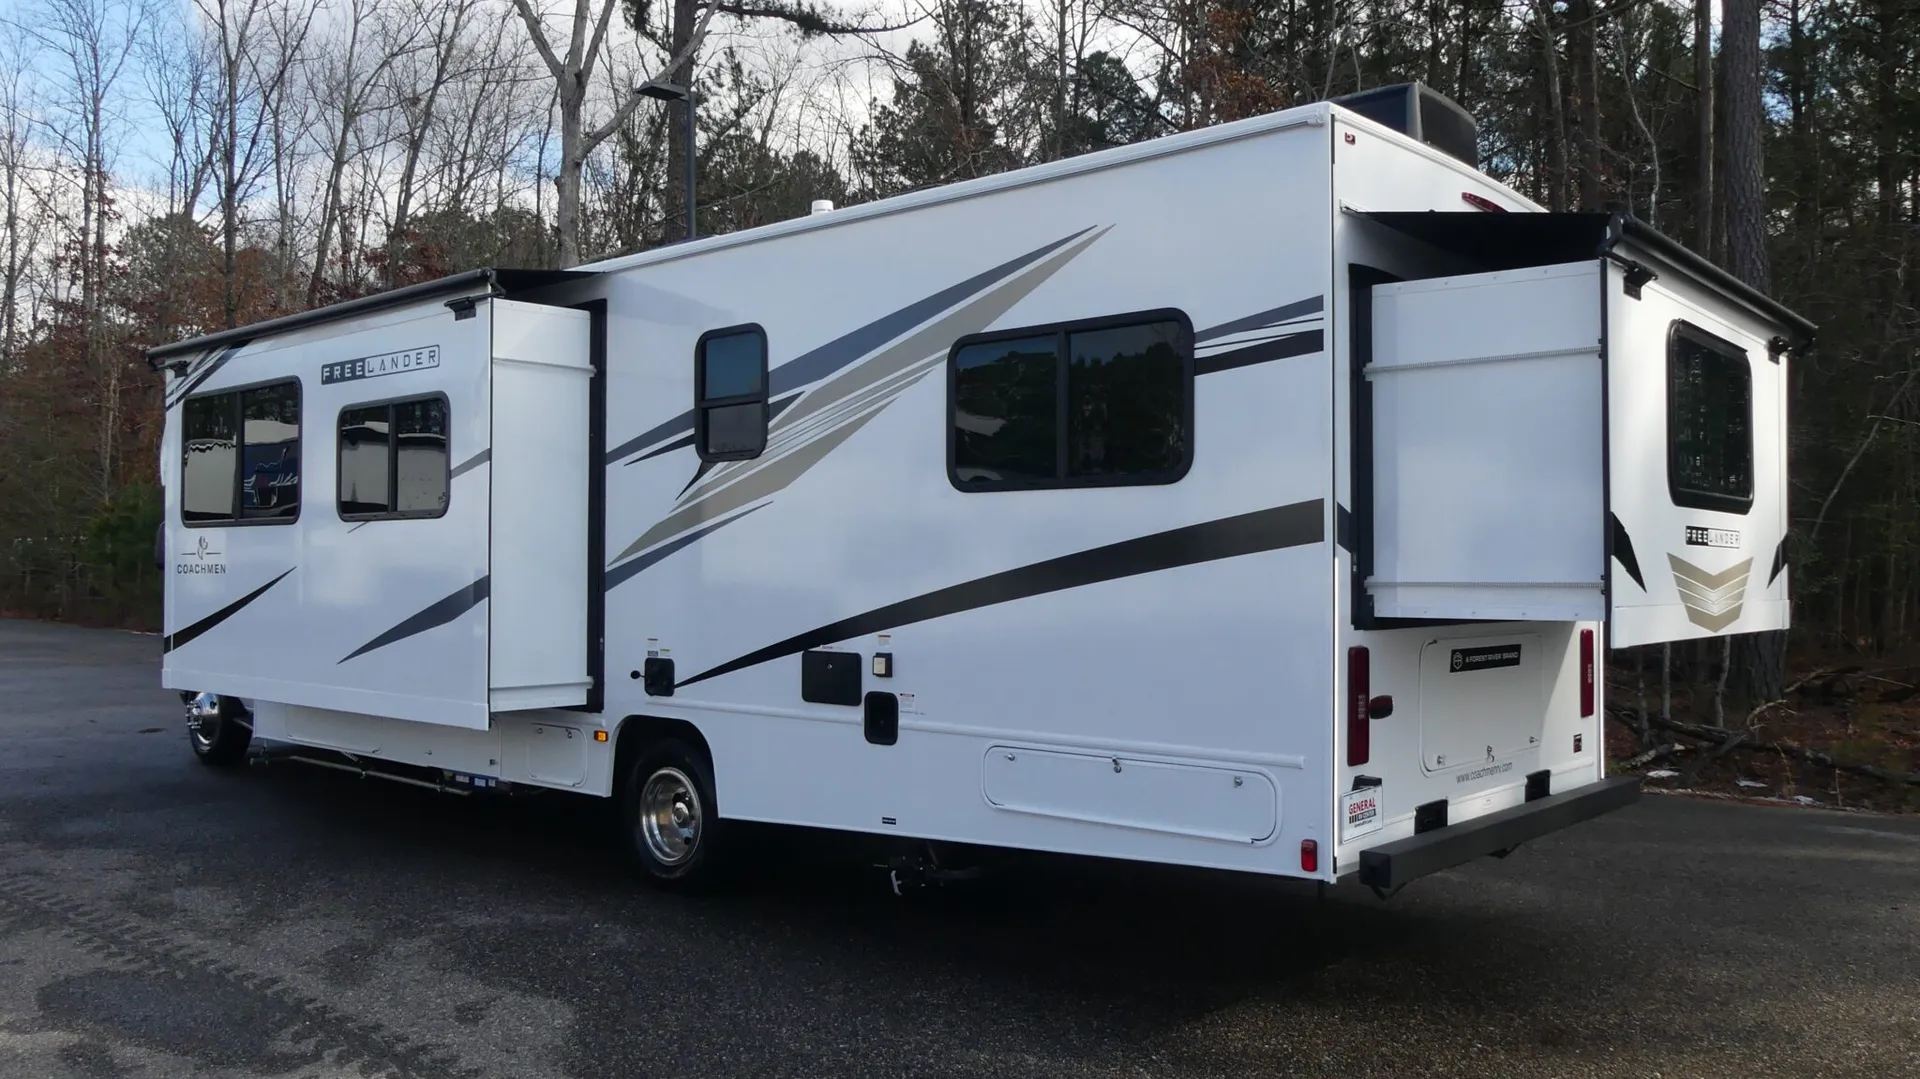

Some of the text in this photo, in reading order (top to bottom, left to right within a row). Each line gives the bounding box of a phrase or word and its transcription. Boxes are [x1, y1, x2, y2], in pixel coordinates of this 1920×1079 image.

[322, 349, 437, 381] FREELANDER
[1685, 529, 1740, 545] FREELANDER
[176, 564, 226, 574] COACHMEN
[1349, 797, 1376, 814] GENERAL
